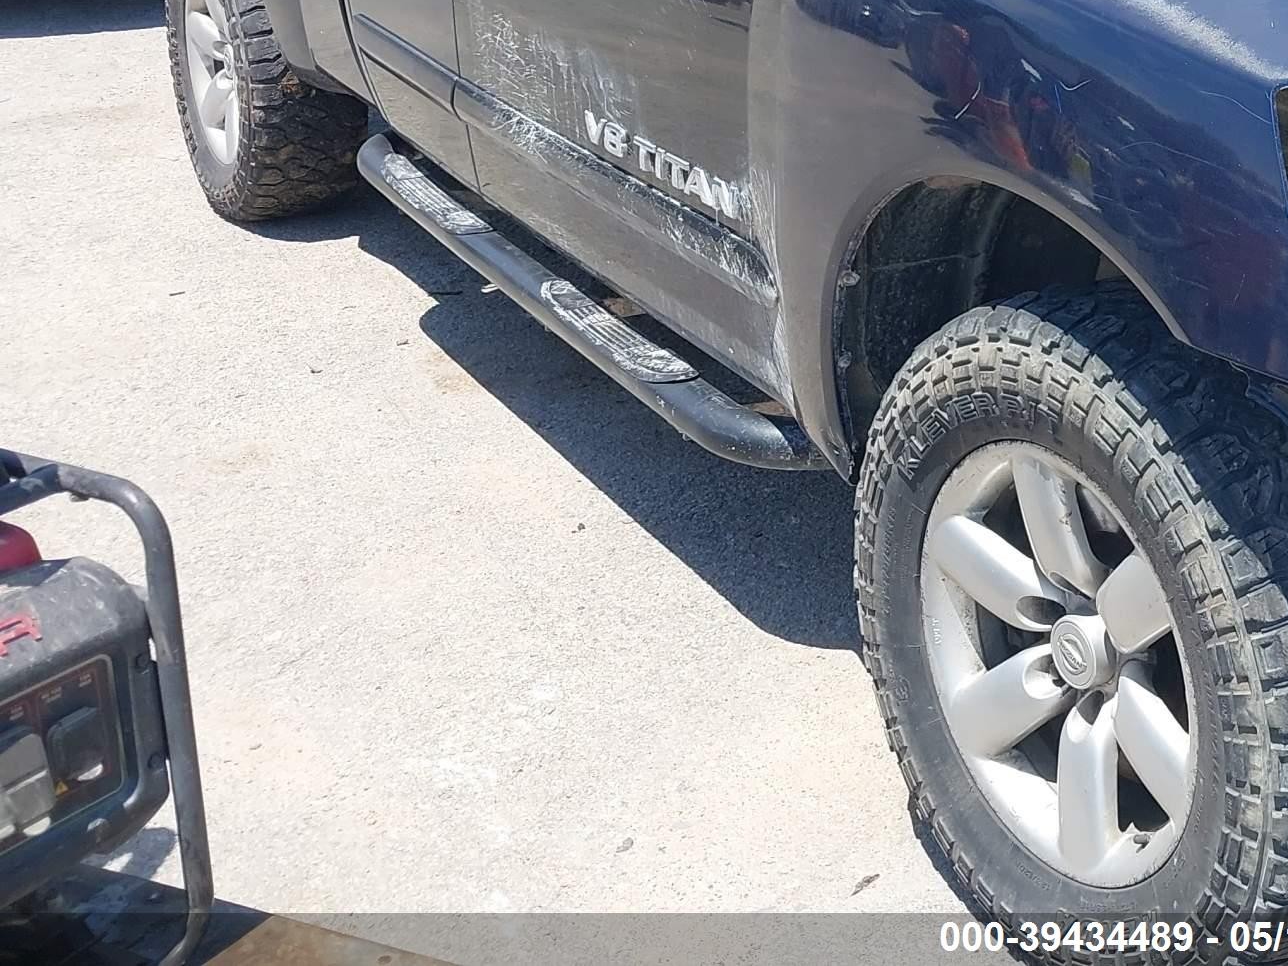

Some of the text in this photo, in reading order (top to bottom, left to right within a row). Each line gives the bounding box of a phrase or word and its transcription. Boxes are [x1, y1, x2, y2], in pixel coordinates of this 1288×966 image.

[584, 109, 740, 220] V8 TITAN
[895, 392, 1000, 481] KLEVER
